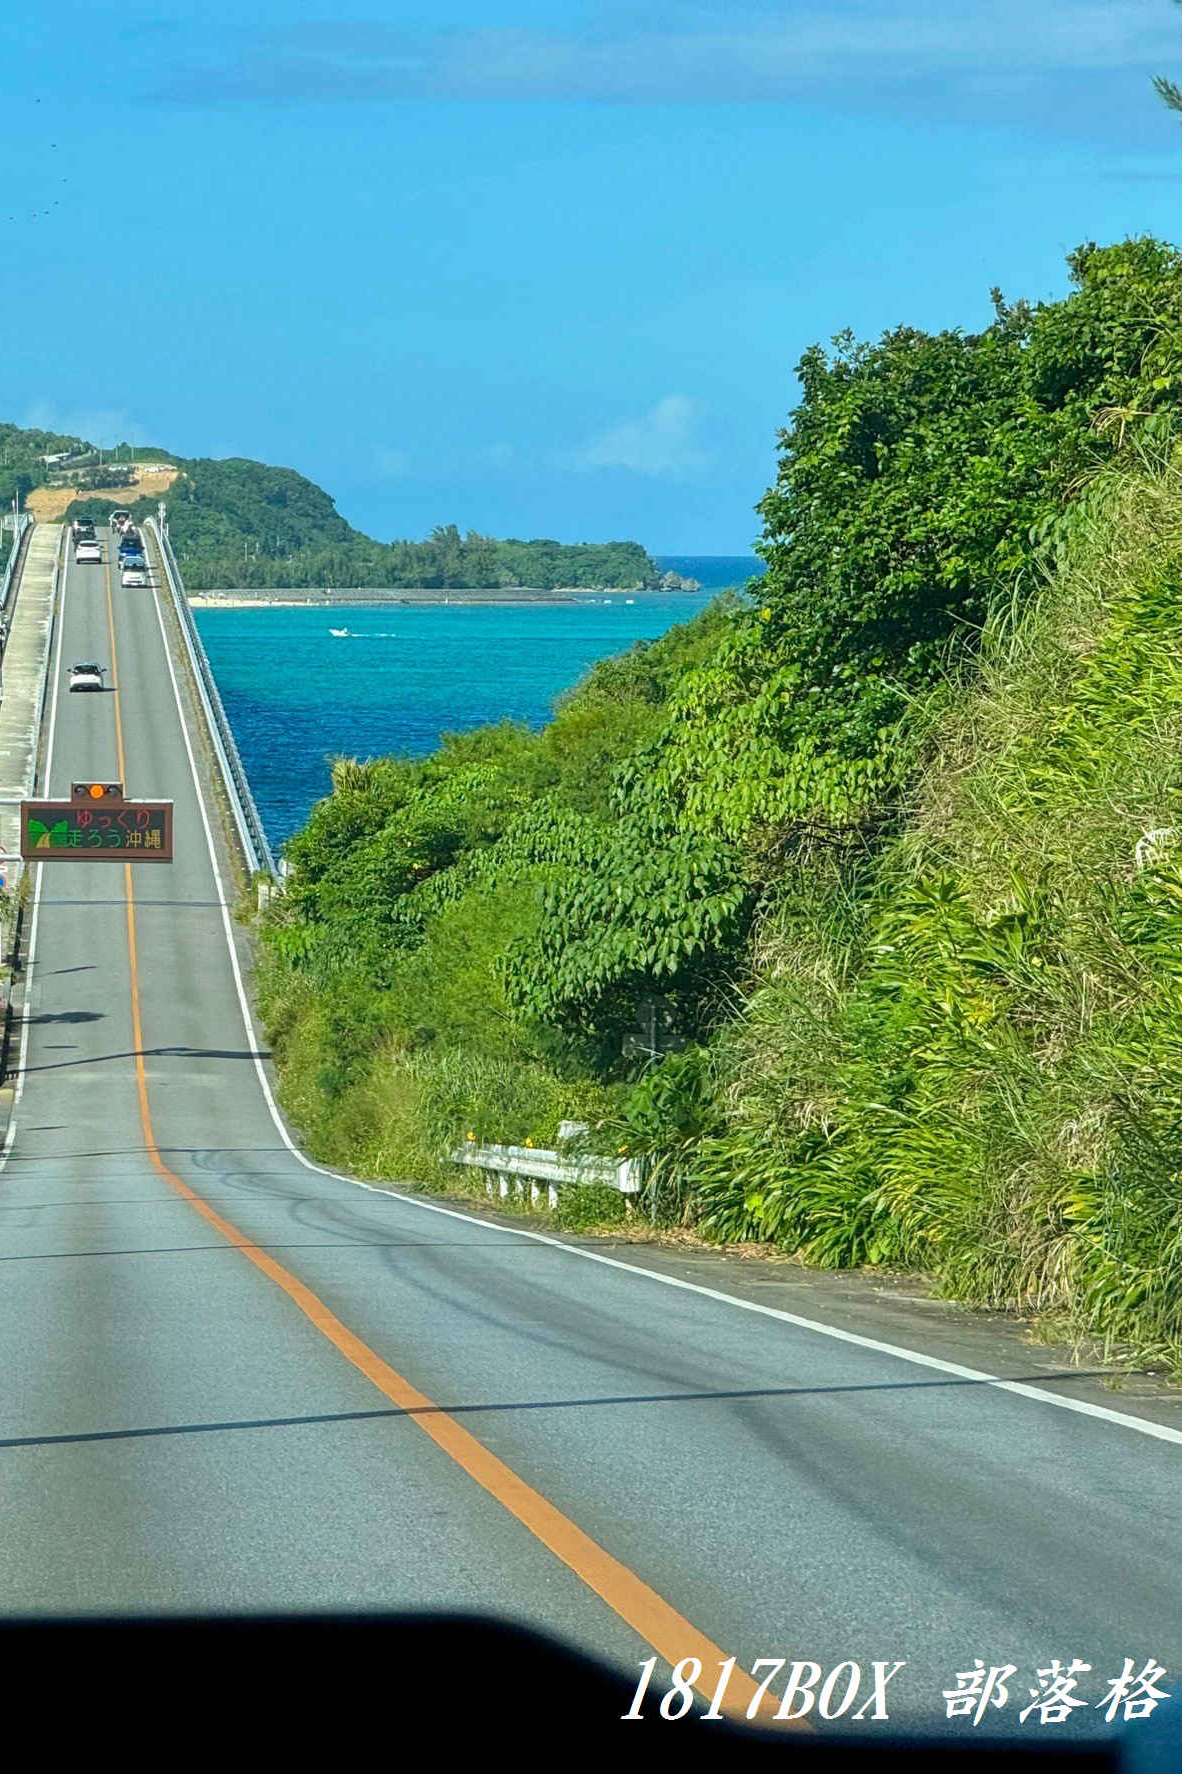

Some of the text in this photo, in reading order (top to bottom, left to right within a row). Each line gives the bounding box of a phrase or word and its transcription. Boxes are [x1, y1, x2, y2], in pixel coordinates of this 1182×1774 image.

[76, 809, 151, 829] ゆっくり
[66, 829, 162, 849] 走ろう沖縄
